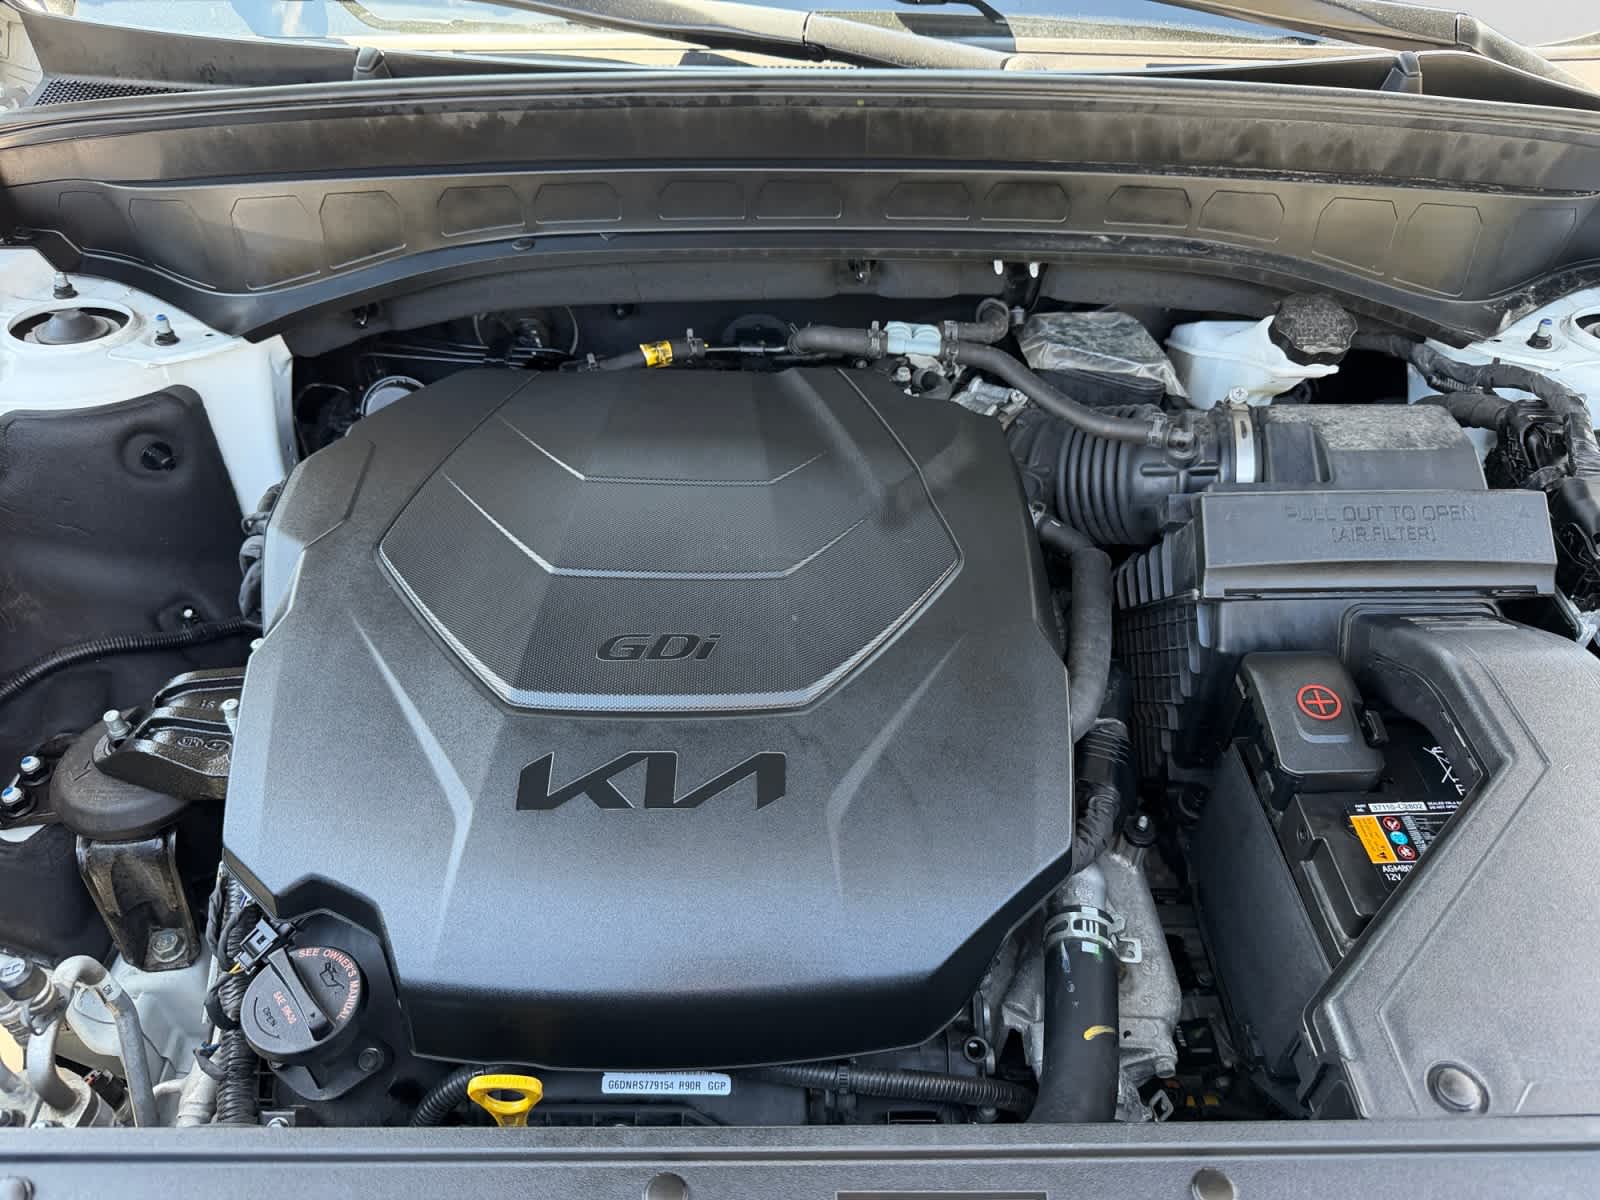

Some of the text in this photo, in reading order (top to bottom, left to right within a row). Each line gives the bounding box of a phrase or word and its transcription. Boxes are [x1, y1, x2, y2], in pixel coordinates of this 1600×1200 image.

[1342, 504, 1384, 522] OUT
[1389, 504, 1416, 521] TO
[1421, 503, 1477, 521] OPEN
[596, 633, 721, 662] GDi
[516, 750, 787, 811] KIA
[1384, 872, 1401, 881] 12V
[299, 947, 320, 958] SEE
[335, 980, 360, 1021] MANUAL
[262, 1006, 277, 1028] OPEN
